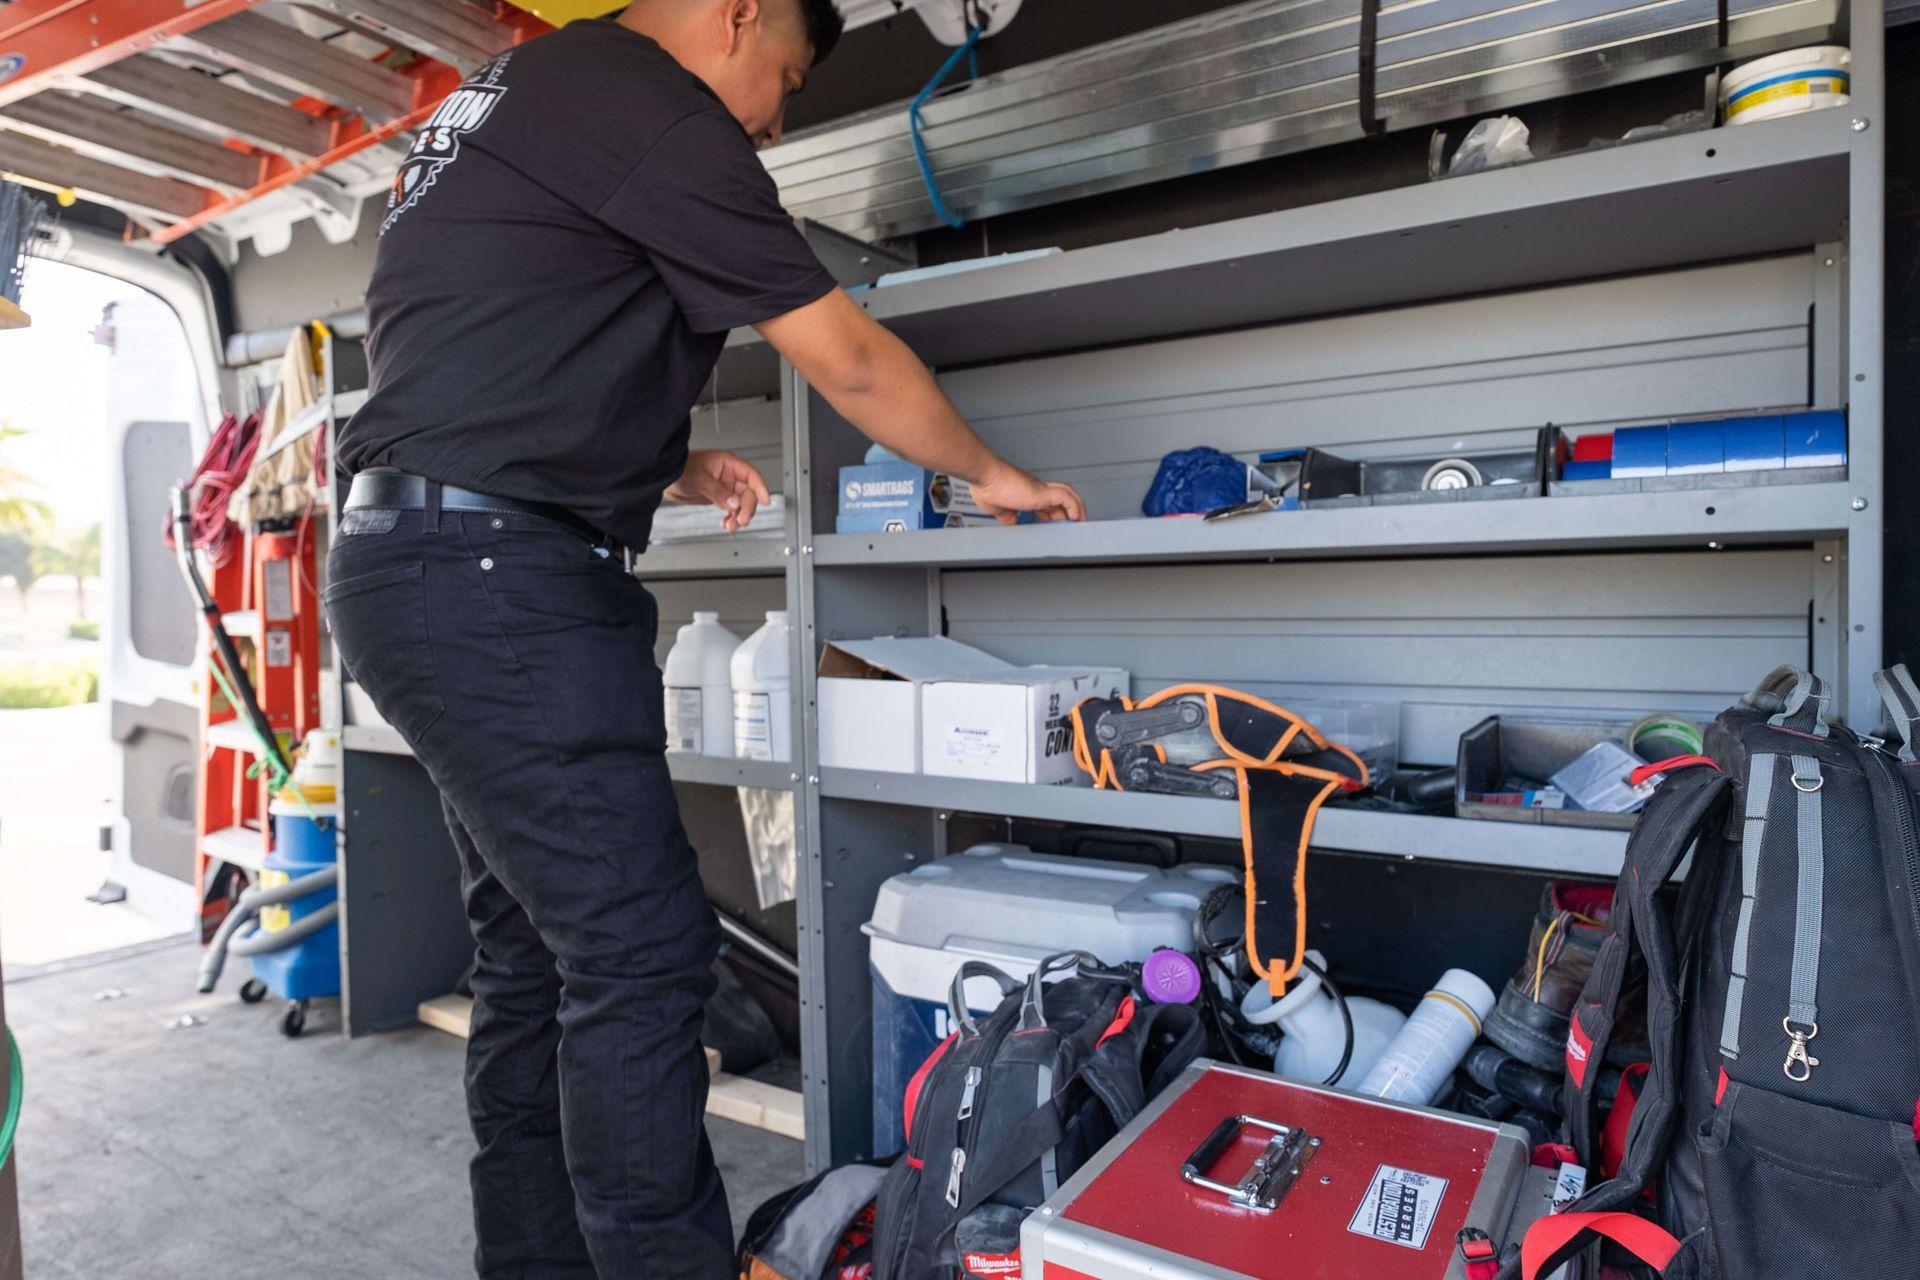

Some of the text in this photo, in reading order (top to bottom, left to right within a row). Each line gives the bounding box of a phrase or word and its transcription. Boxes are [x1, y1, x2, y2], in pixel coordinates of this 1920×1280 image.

[1375, 1181, 1403, 1239] RESTORATION
[1400, 1188, 1416, 1239] HEROES
[966, 1255, 1020, 1269] Milwaukee
